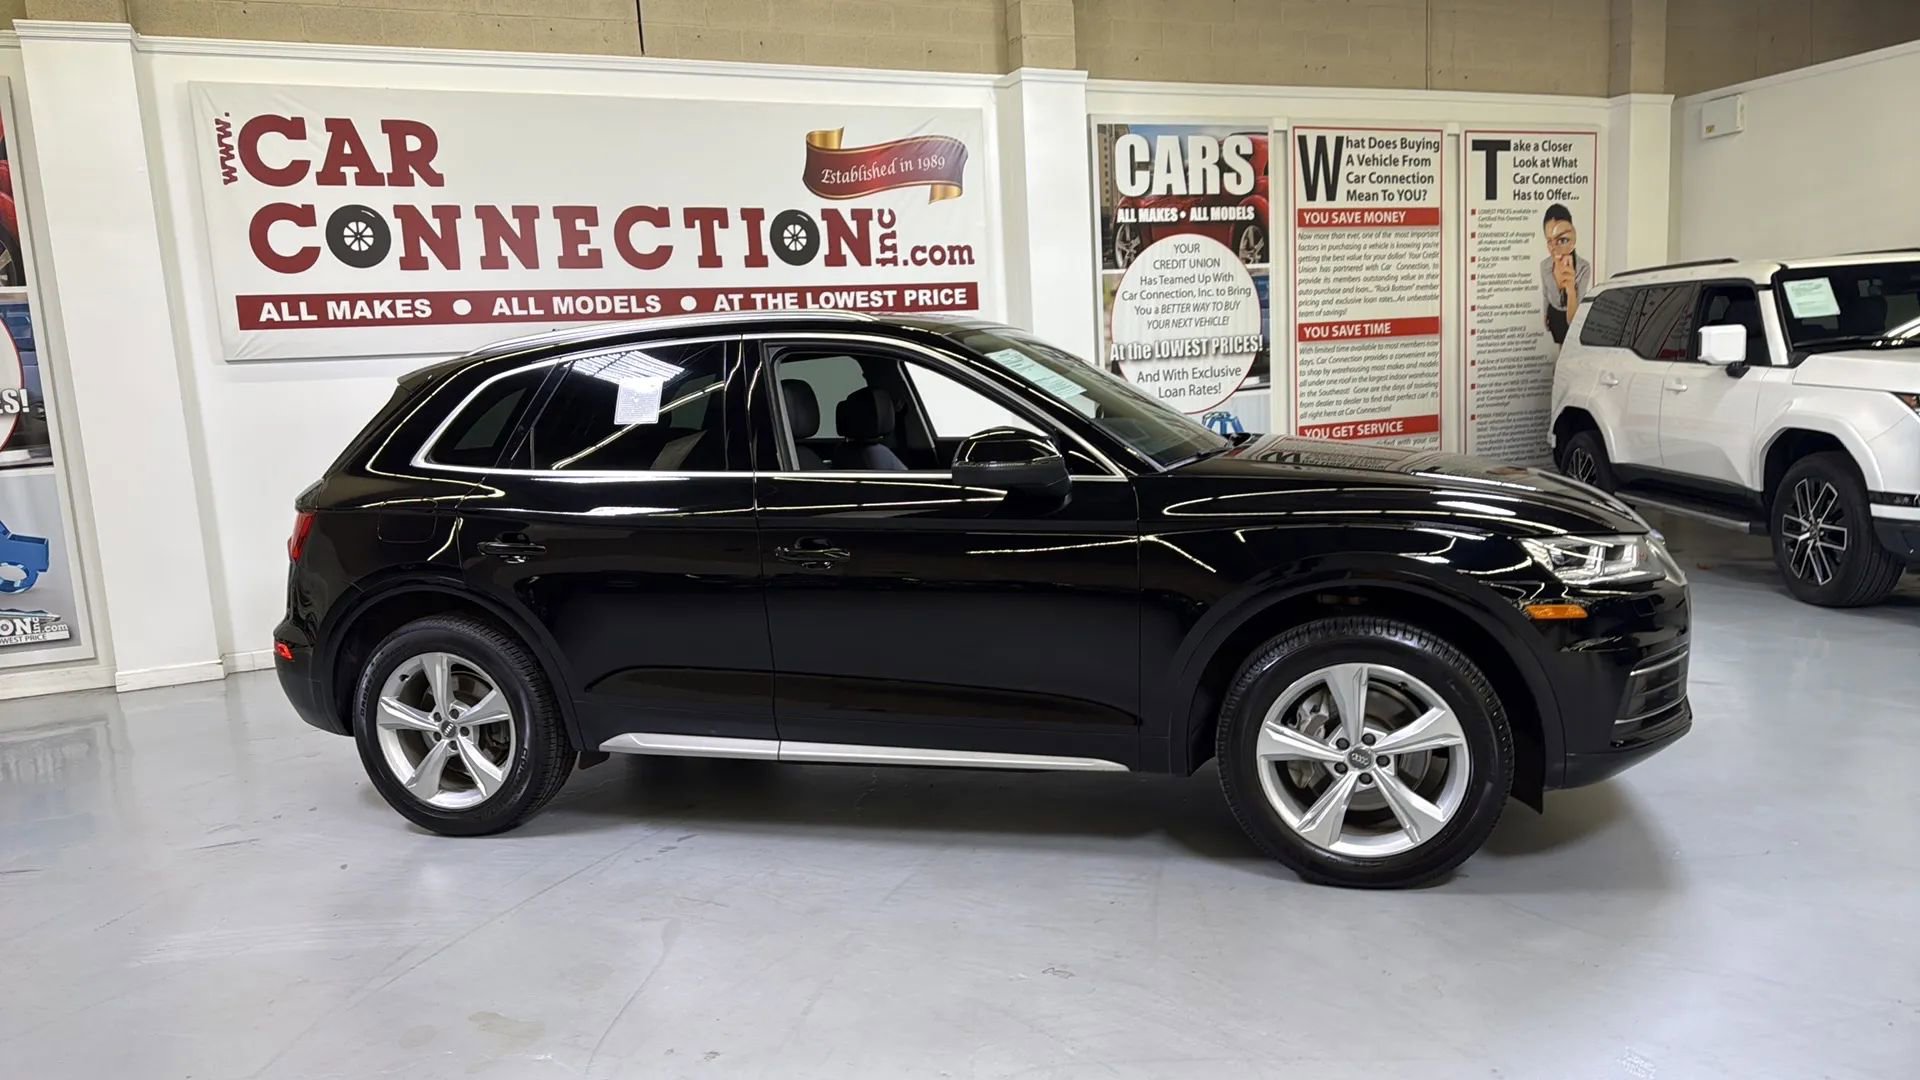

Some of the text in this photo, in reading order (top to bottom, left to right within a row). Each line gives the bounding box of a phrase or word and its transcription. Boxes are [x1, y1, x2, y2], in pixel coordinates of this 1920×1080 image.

[238, 114, 444, 187] CAR
[1368, 137, 1397, 149] Does
[1400, 137, 1440, 153] Buying
[1533, 142, 1539, 152] a
[1541, 140, 1572, 152] Closer
[1115, 134, 1255, 196] CARS
[1346, 154, 1431, 167] A Vehicle From
[1513, 156, 1577, 168] Look at What
[821, 154, 945, 184] Established in 1989
[1346, 172, 1434, 184] Car Connection
[1513, 172, 1588, 184] Car Connection
[1346, 189, 1427, 202] Mean To YOU?
[1513, 189, 1580, 201] Has to Offer...
[1117, 205, 1255, 223] ALL MAKES ALL MODELS
[1304, 211, 1406, 224] YOU SAVE MONEY
[249, 202, 873, 274] CONNECTION
[903, 245, 975, 266] .com
[1173, 243, 1200, 254] YOUR
[1153, 257, 1220, 270] CREDIT UNION
[1140, 273, 1234, 286] Has Teamed Up With
[1122, 286, 1251, 301] Car Connection, Inc. to Bring
[259, 288, 967, 322] ALL MAKES ALL MODELS AT THE LOWEST PRICE
[1134, 305, 1151, 315] You
[1161, 303, 1191, 314] BETTER
[1192, 302, 1210, 313] WAY
[1212, 301, 1223, 311] TO
[1224, 300, 1241, 311] BUY
[1147, 316, 1230, 329] YOUR NEXT VEHICLE!
[1304, 322, 1391, 339] YOU SAVE TIME
[1110, 334, 1263, 361] At the LOWEST PRICES!
[1137, 366, 1242, 383] And With Exclusive
[1158, 382, 1221, 398] Loan Rates!
[1305, 421, 1404, 440] YOU GET SERVICE
